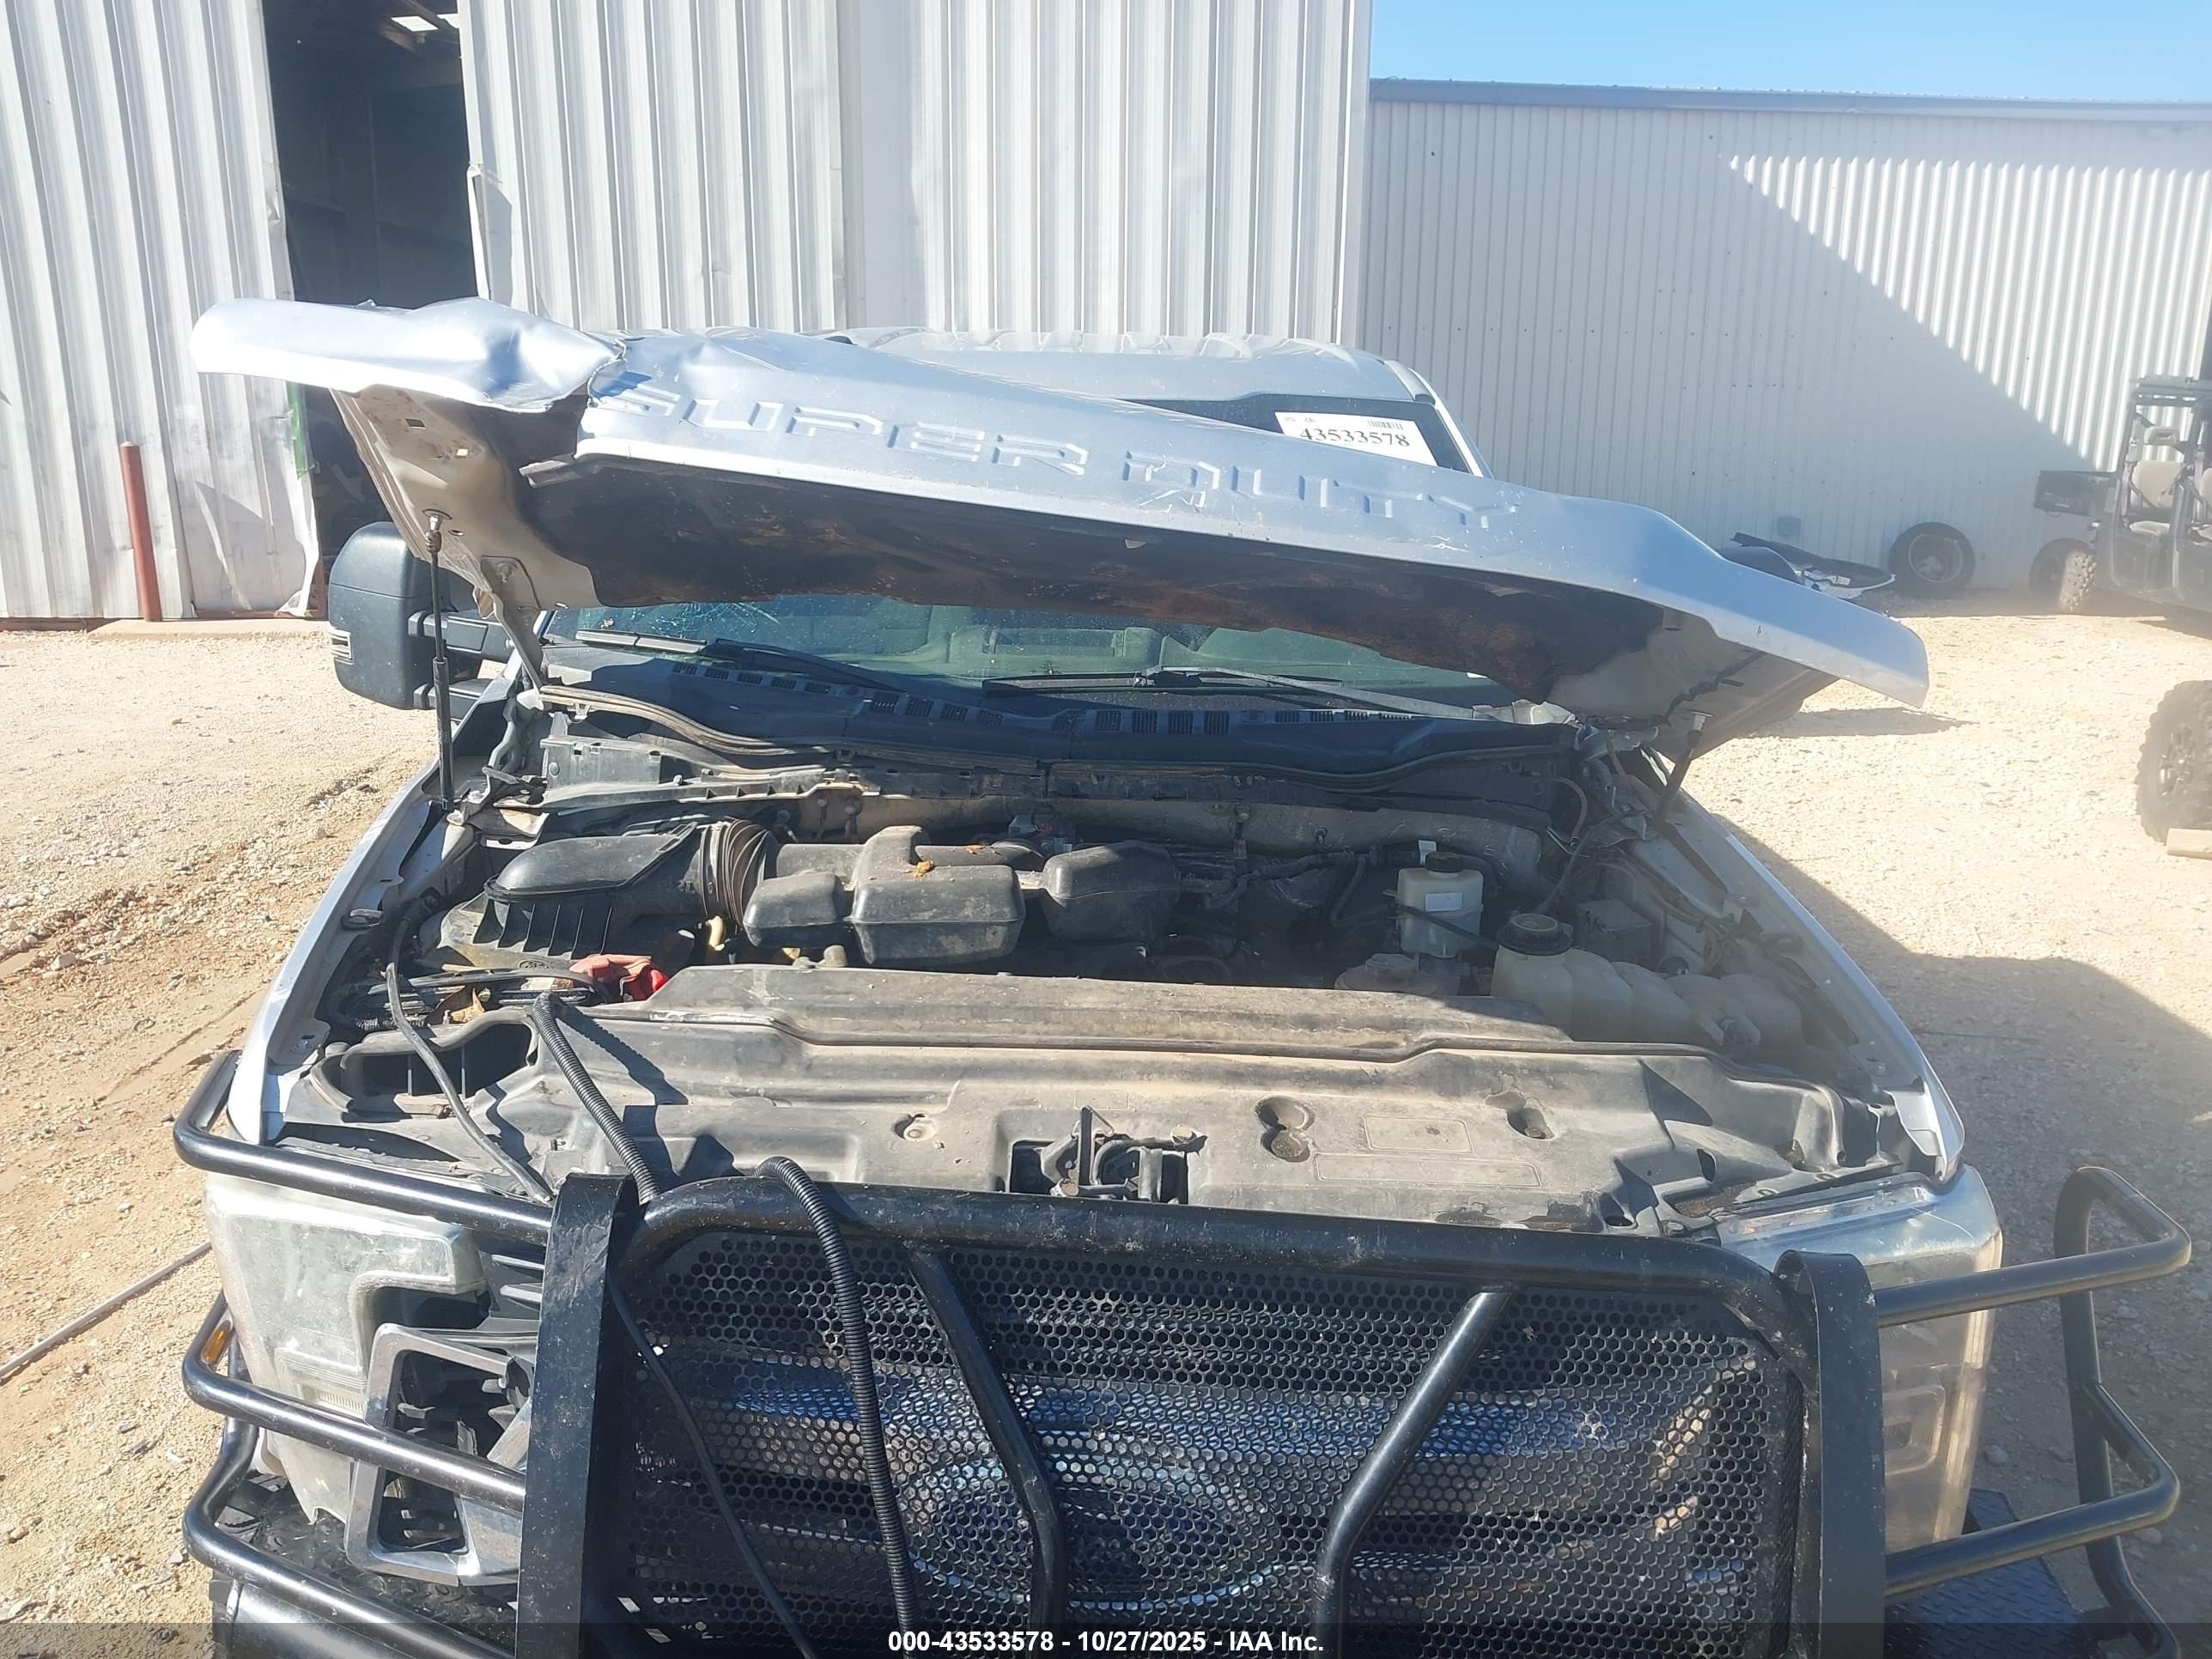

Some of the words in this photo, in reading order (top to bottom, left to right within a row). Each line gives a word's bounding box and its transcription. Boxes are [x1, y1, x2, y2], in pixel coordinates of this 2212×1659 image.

[595, 384, 1089, 475] SUPER
[1122, 450, 1516, 529] DUTY
[1299, 427, 1410, 447] 43533578
